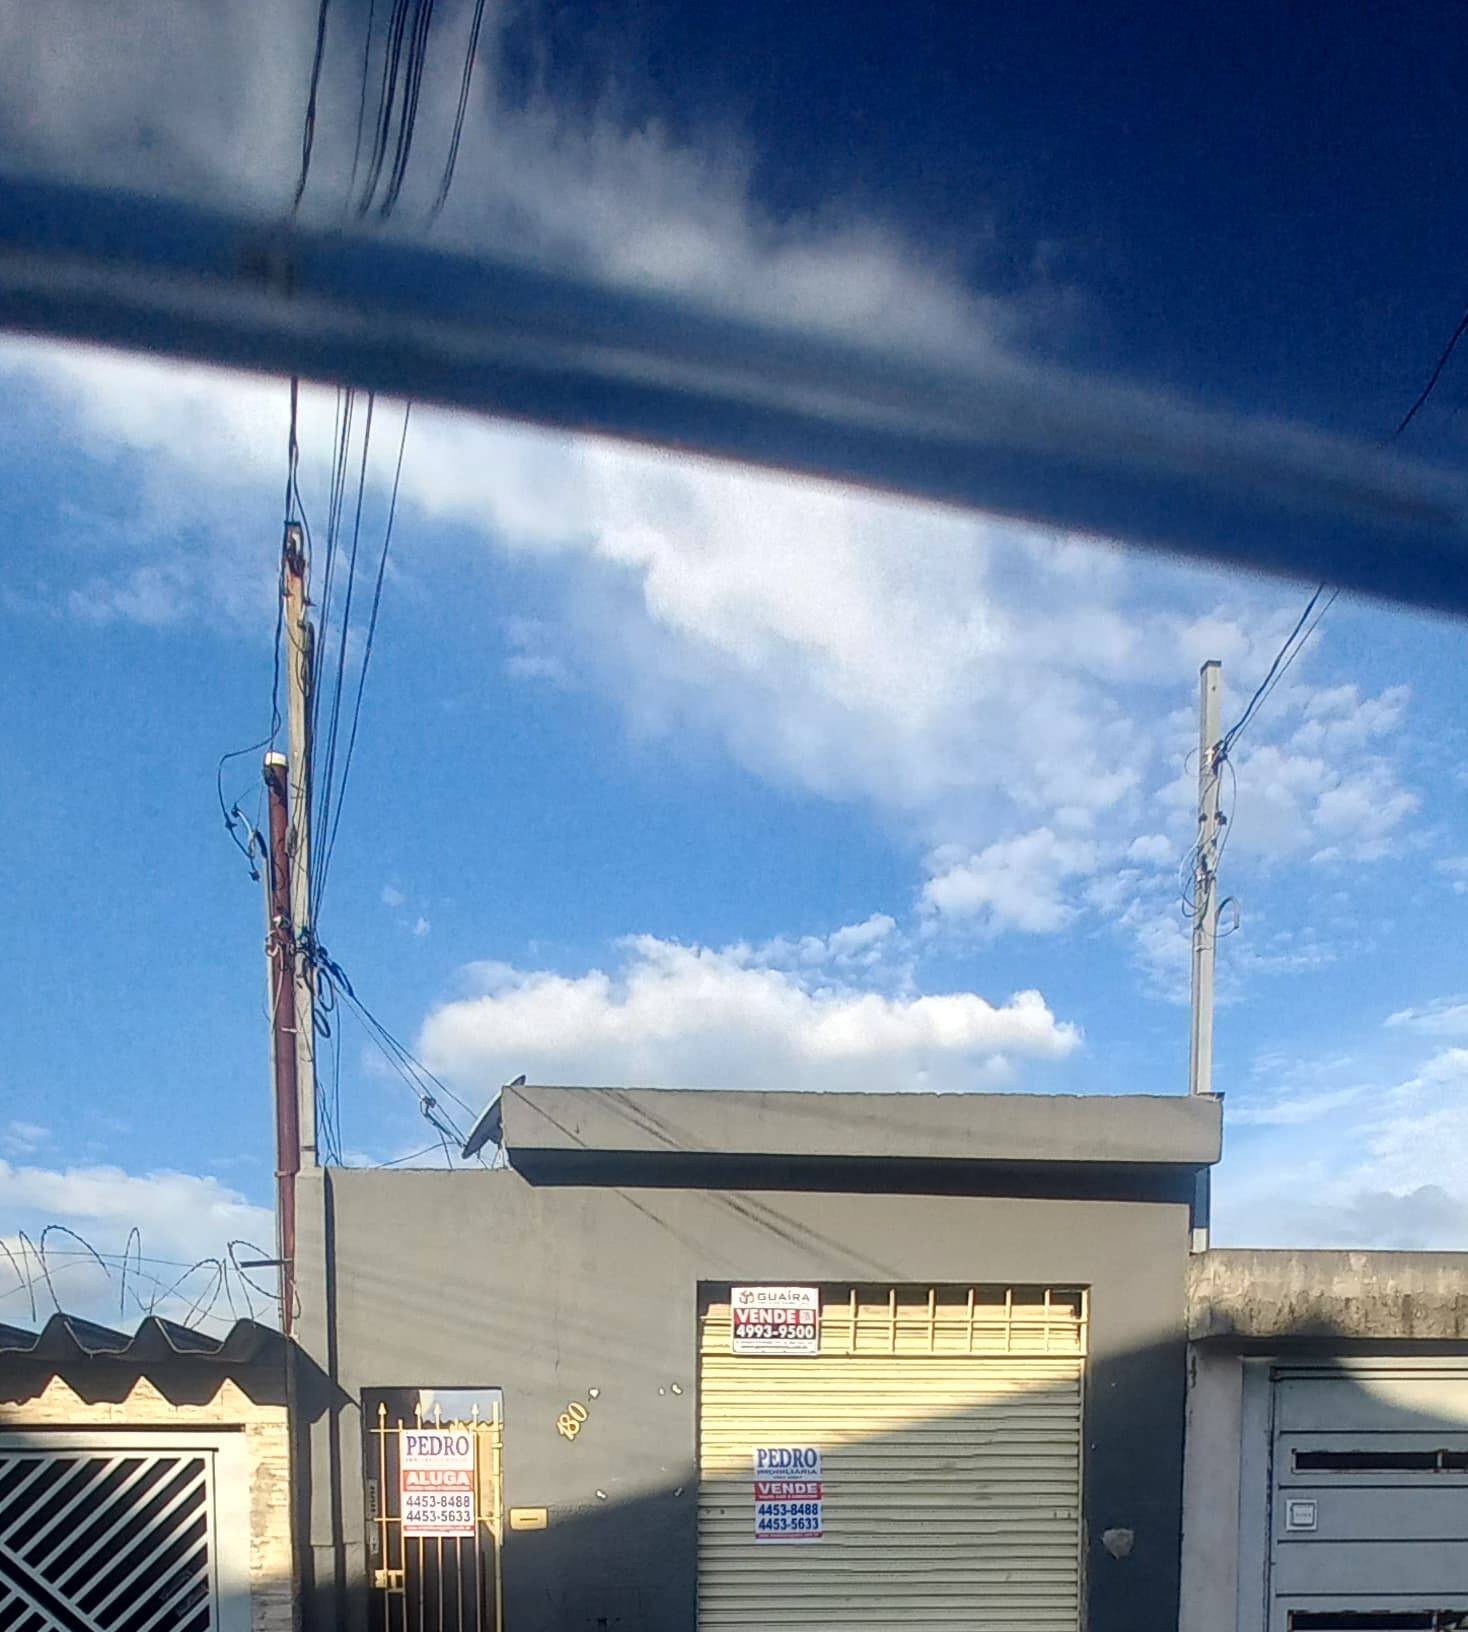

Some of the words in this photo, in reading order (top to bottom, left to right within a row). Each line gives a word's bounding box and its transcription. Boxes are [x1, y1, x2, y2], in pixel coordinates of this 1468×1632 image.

[757, 1290, 810, 1301] GUAÍRA
[736, 1308, 797, 1324] VENDE
[736, 1324, 814, 1338] 4993-9500
[406, 1435, 470, 1456] PEDRO
[757, 1448, 818, 1468] PEDRO
[407, 1471, 471, 1486] ALUGA
[758, 1482, 818, 1494] VENDE
[406, 1495, 471, 1508] 4453-8488
[406, 1510, 471, 1522] 4453-5633
[758, 1503, 819, 1516] 4453-8488
[758, 1518, 819, 1531] 4453-5633
